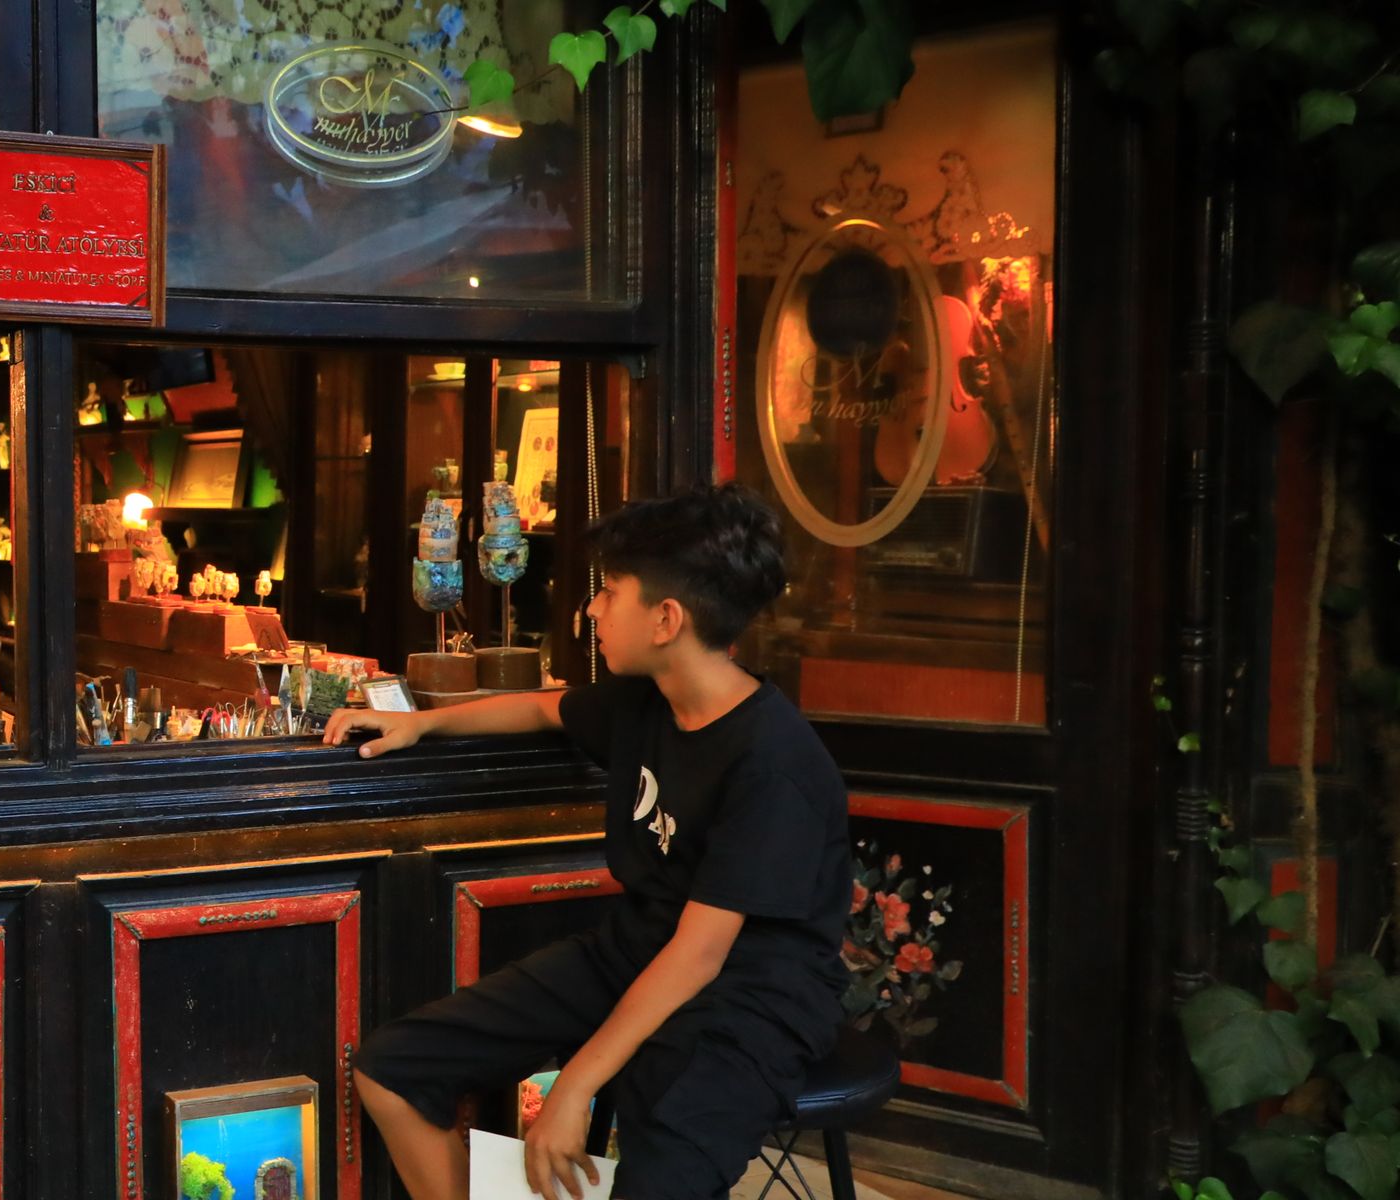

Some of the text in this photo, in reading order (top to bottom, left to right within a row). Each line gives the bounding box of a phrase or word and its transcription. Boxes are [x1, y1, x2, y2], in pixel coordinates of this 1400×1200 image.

[39, 204, 55, 221] &
[56, 234, 146, 257] ATÖLYESİ
[15, 270, 25, 281] &
